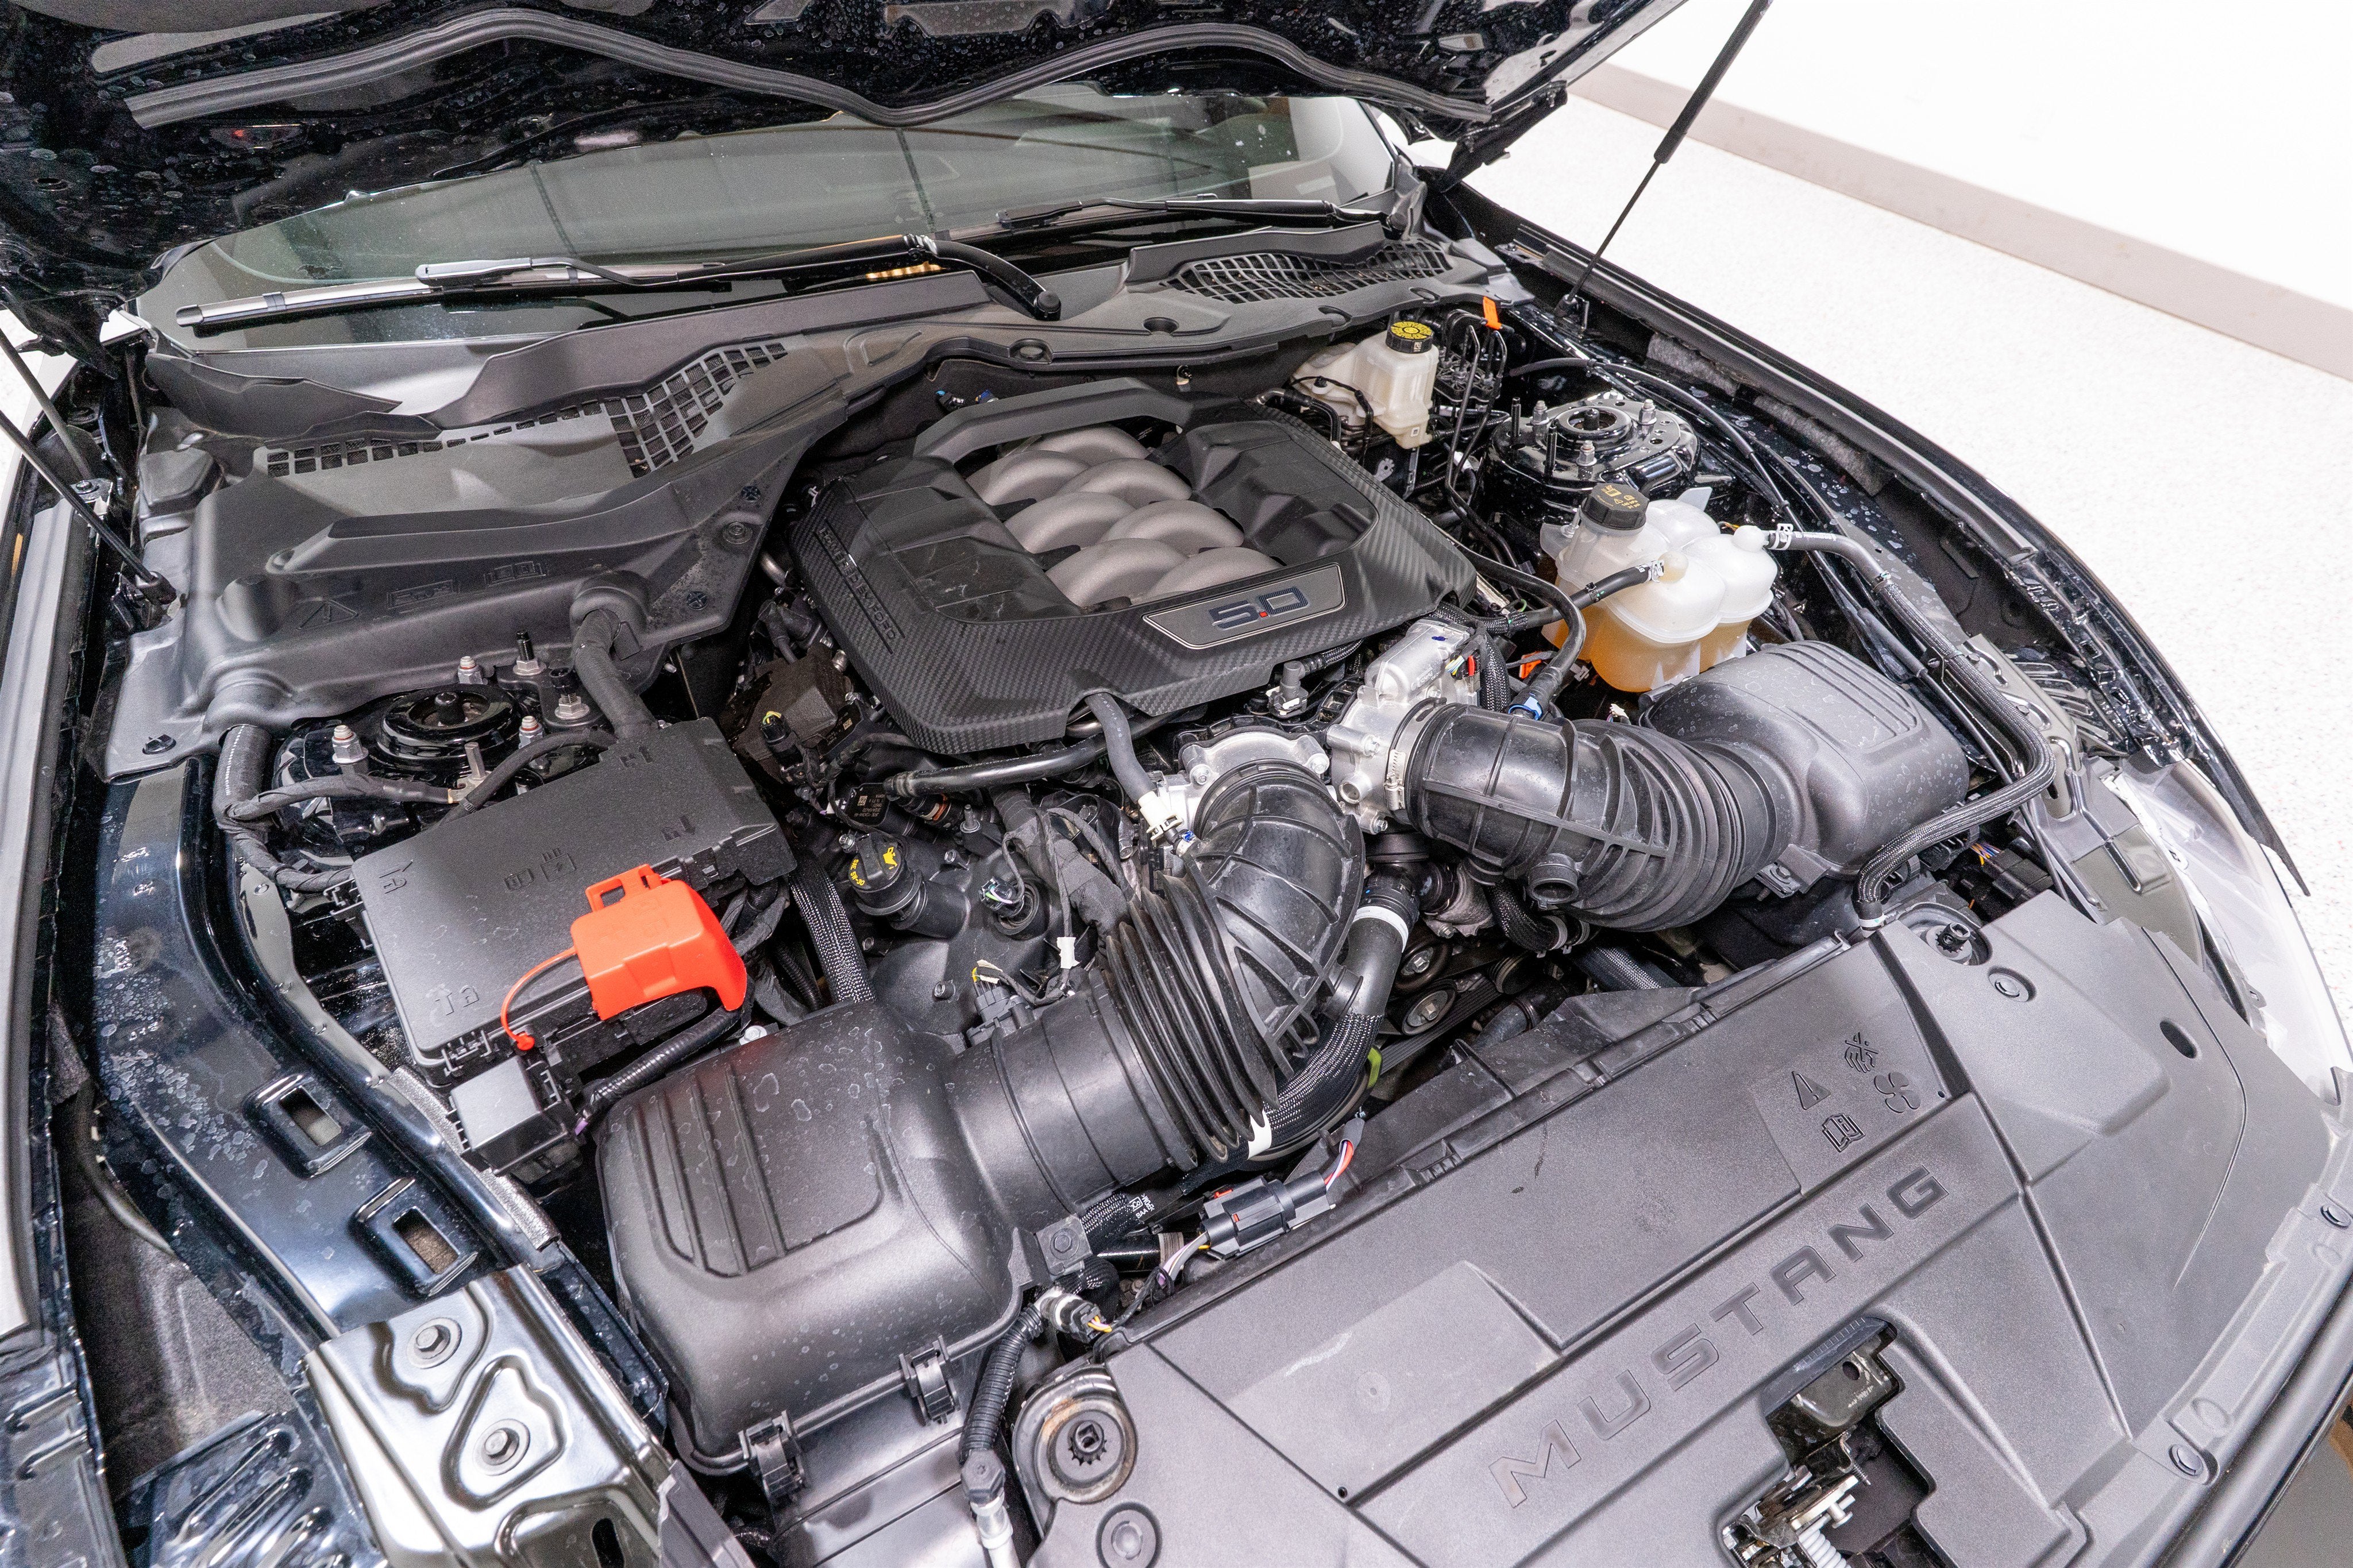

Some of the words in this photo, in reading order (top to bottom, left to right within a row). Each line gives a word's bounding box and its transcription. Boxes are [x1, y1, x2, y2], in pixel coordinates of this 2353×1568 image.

[867, 602, 897, 641] FORD
[1209, 587, 1309, 631] 5.0
[850, 859, 859, 870] SAE
[850, 871, 865, 886] 5W-30
[1136, 1208, 1148, 1218] BAA
[1488, 1165, 1949, 1508] MUSTANG
